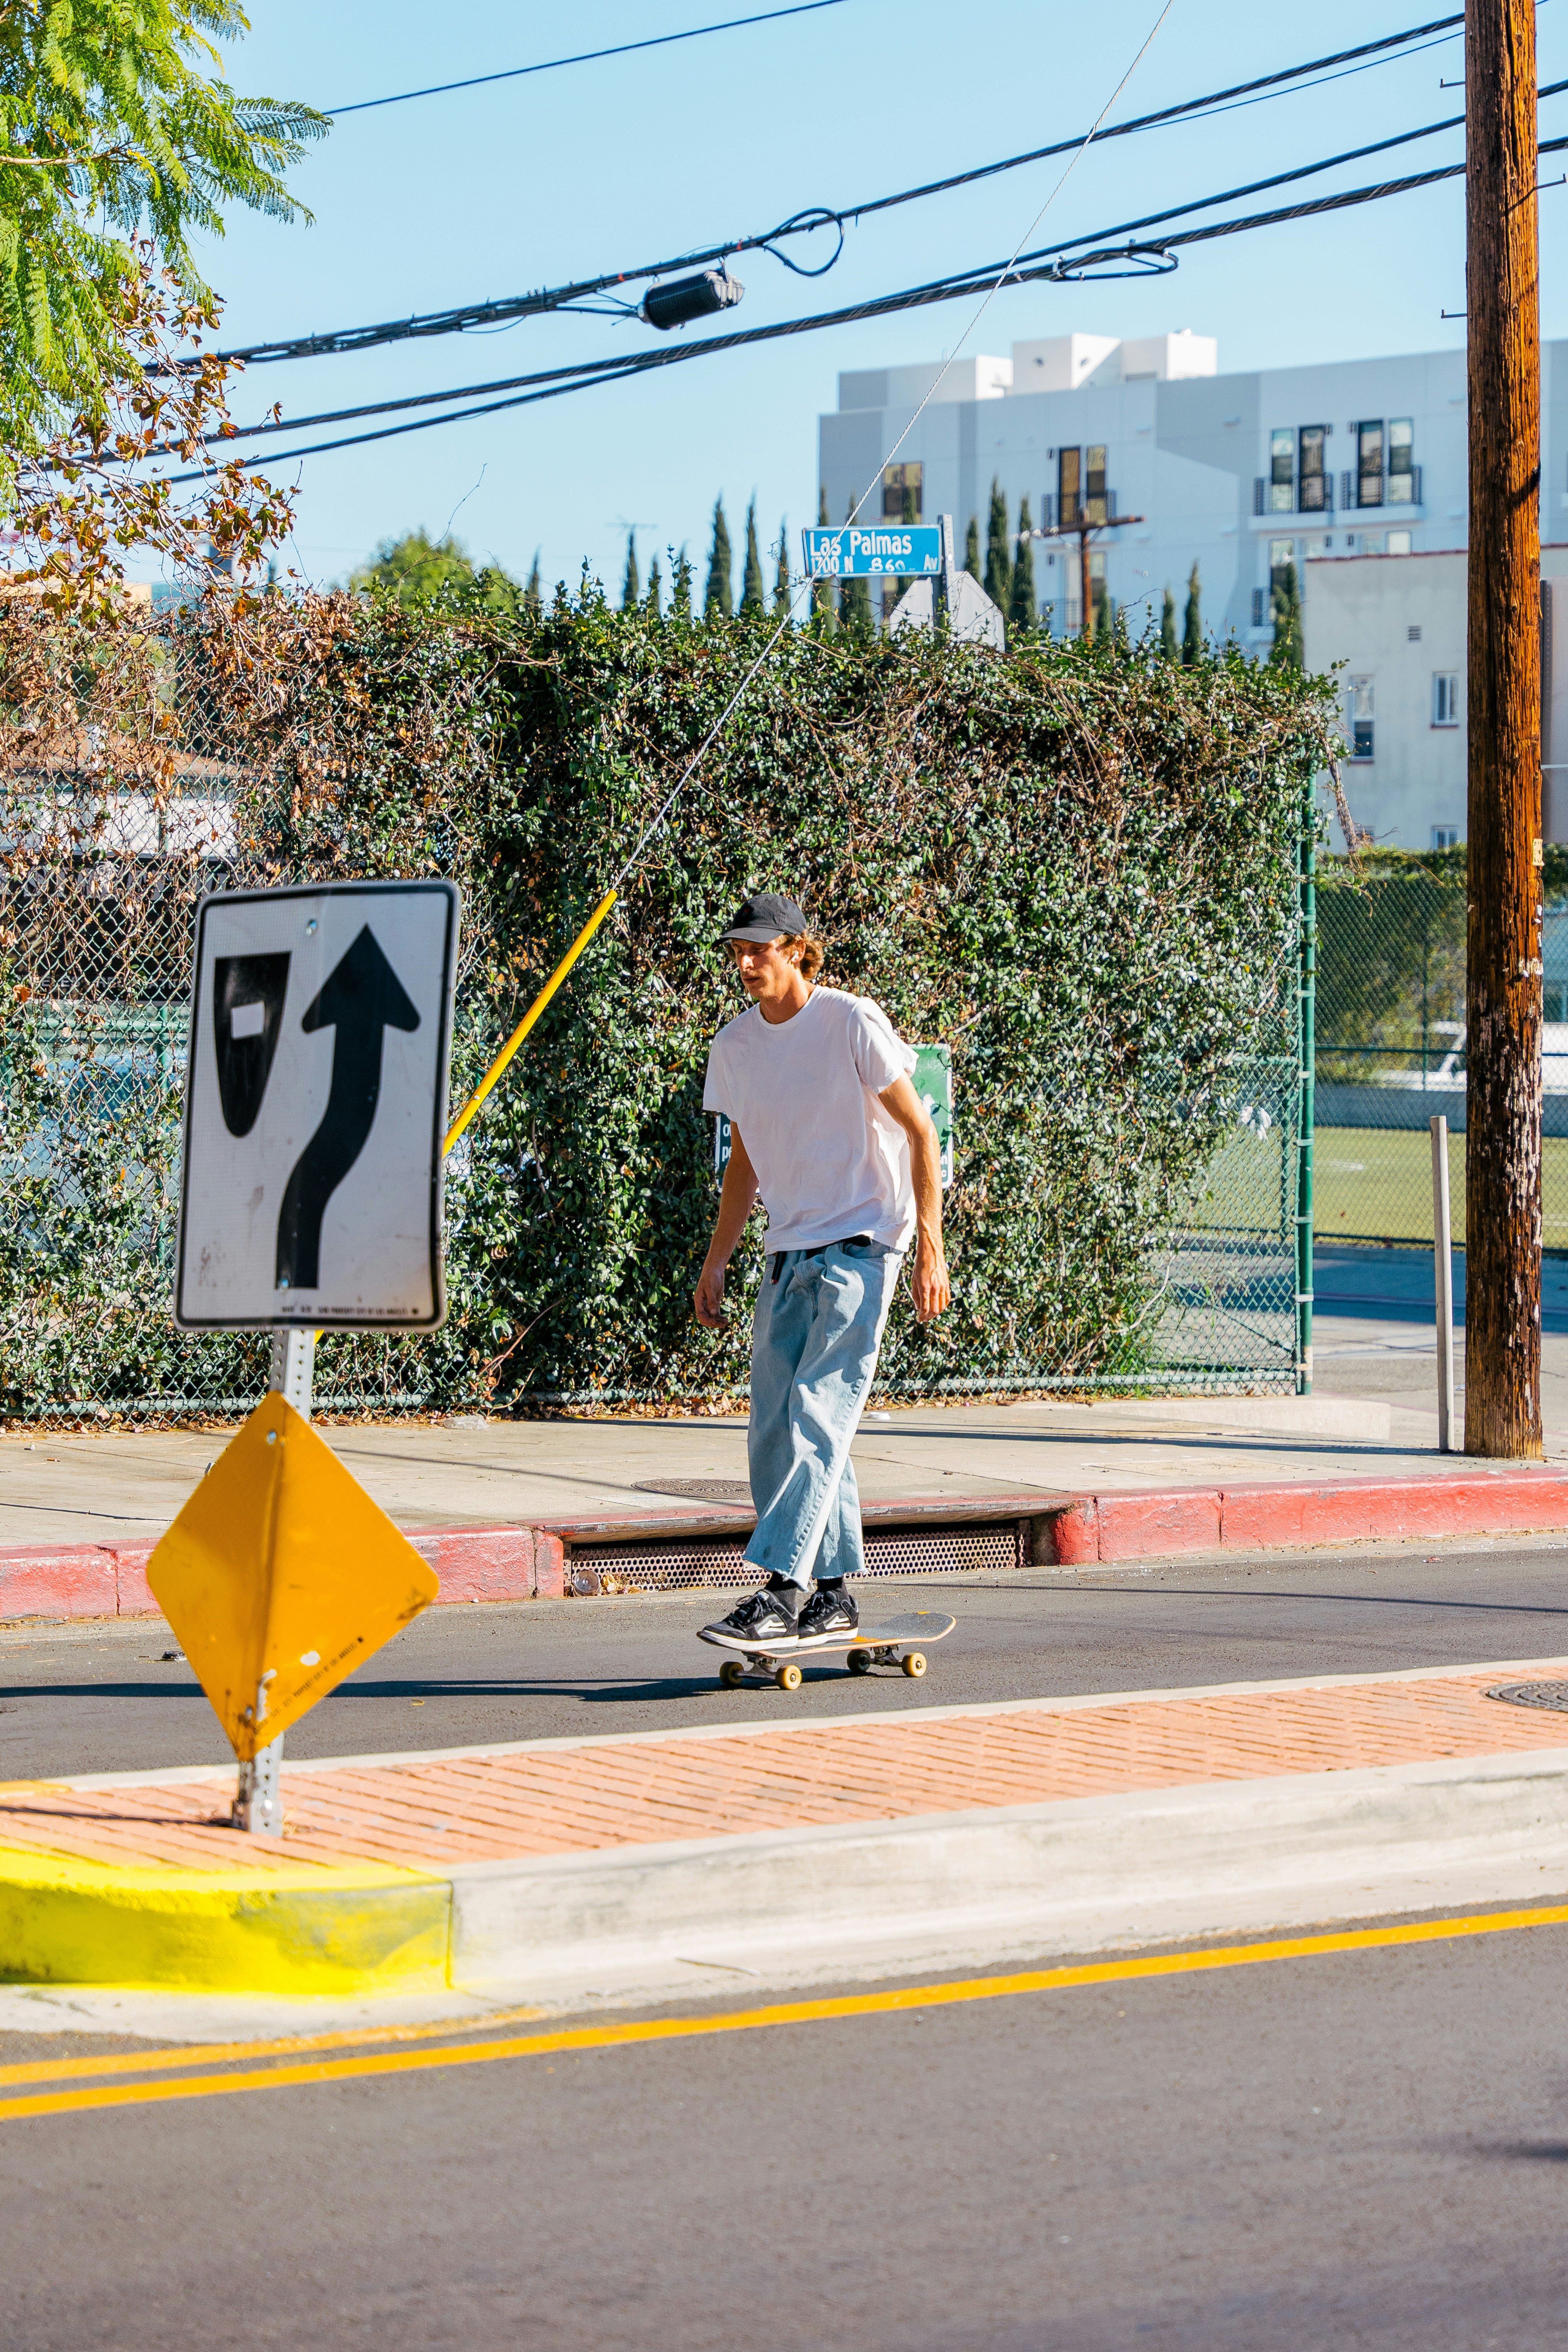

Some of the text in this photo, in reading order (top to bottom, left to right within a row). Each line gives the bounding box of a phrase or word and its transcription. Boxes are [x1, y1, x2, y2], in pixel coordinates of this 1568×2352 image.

[810, 531, 913, 556] Las Palmas
[810, 556, 840, 574] 1700
[844, 556, 854, 573] N
